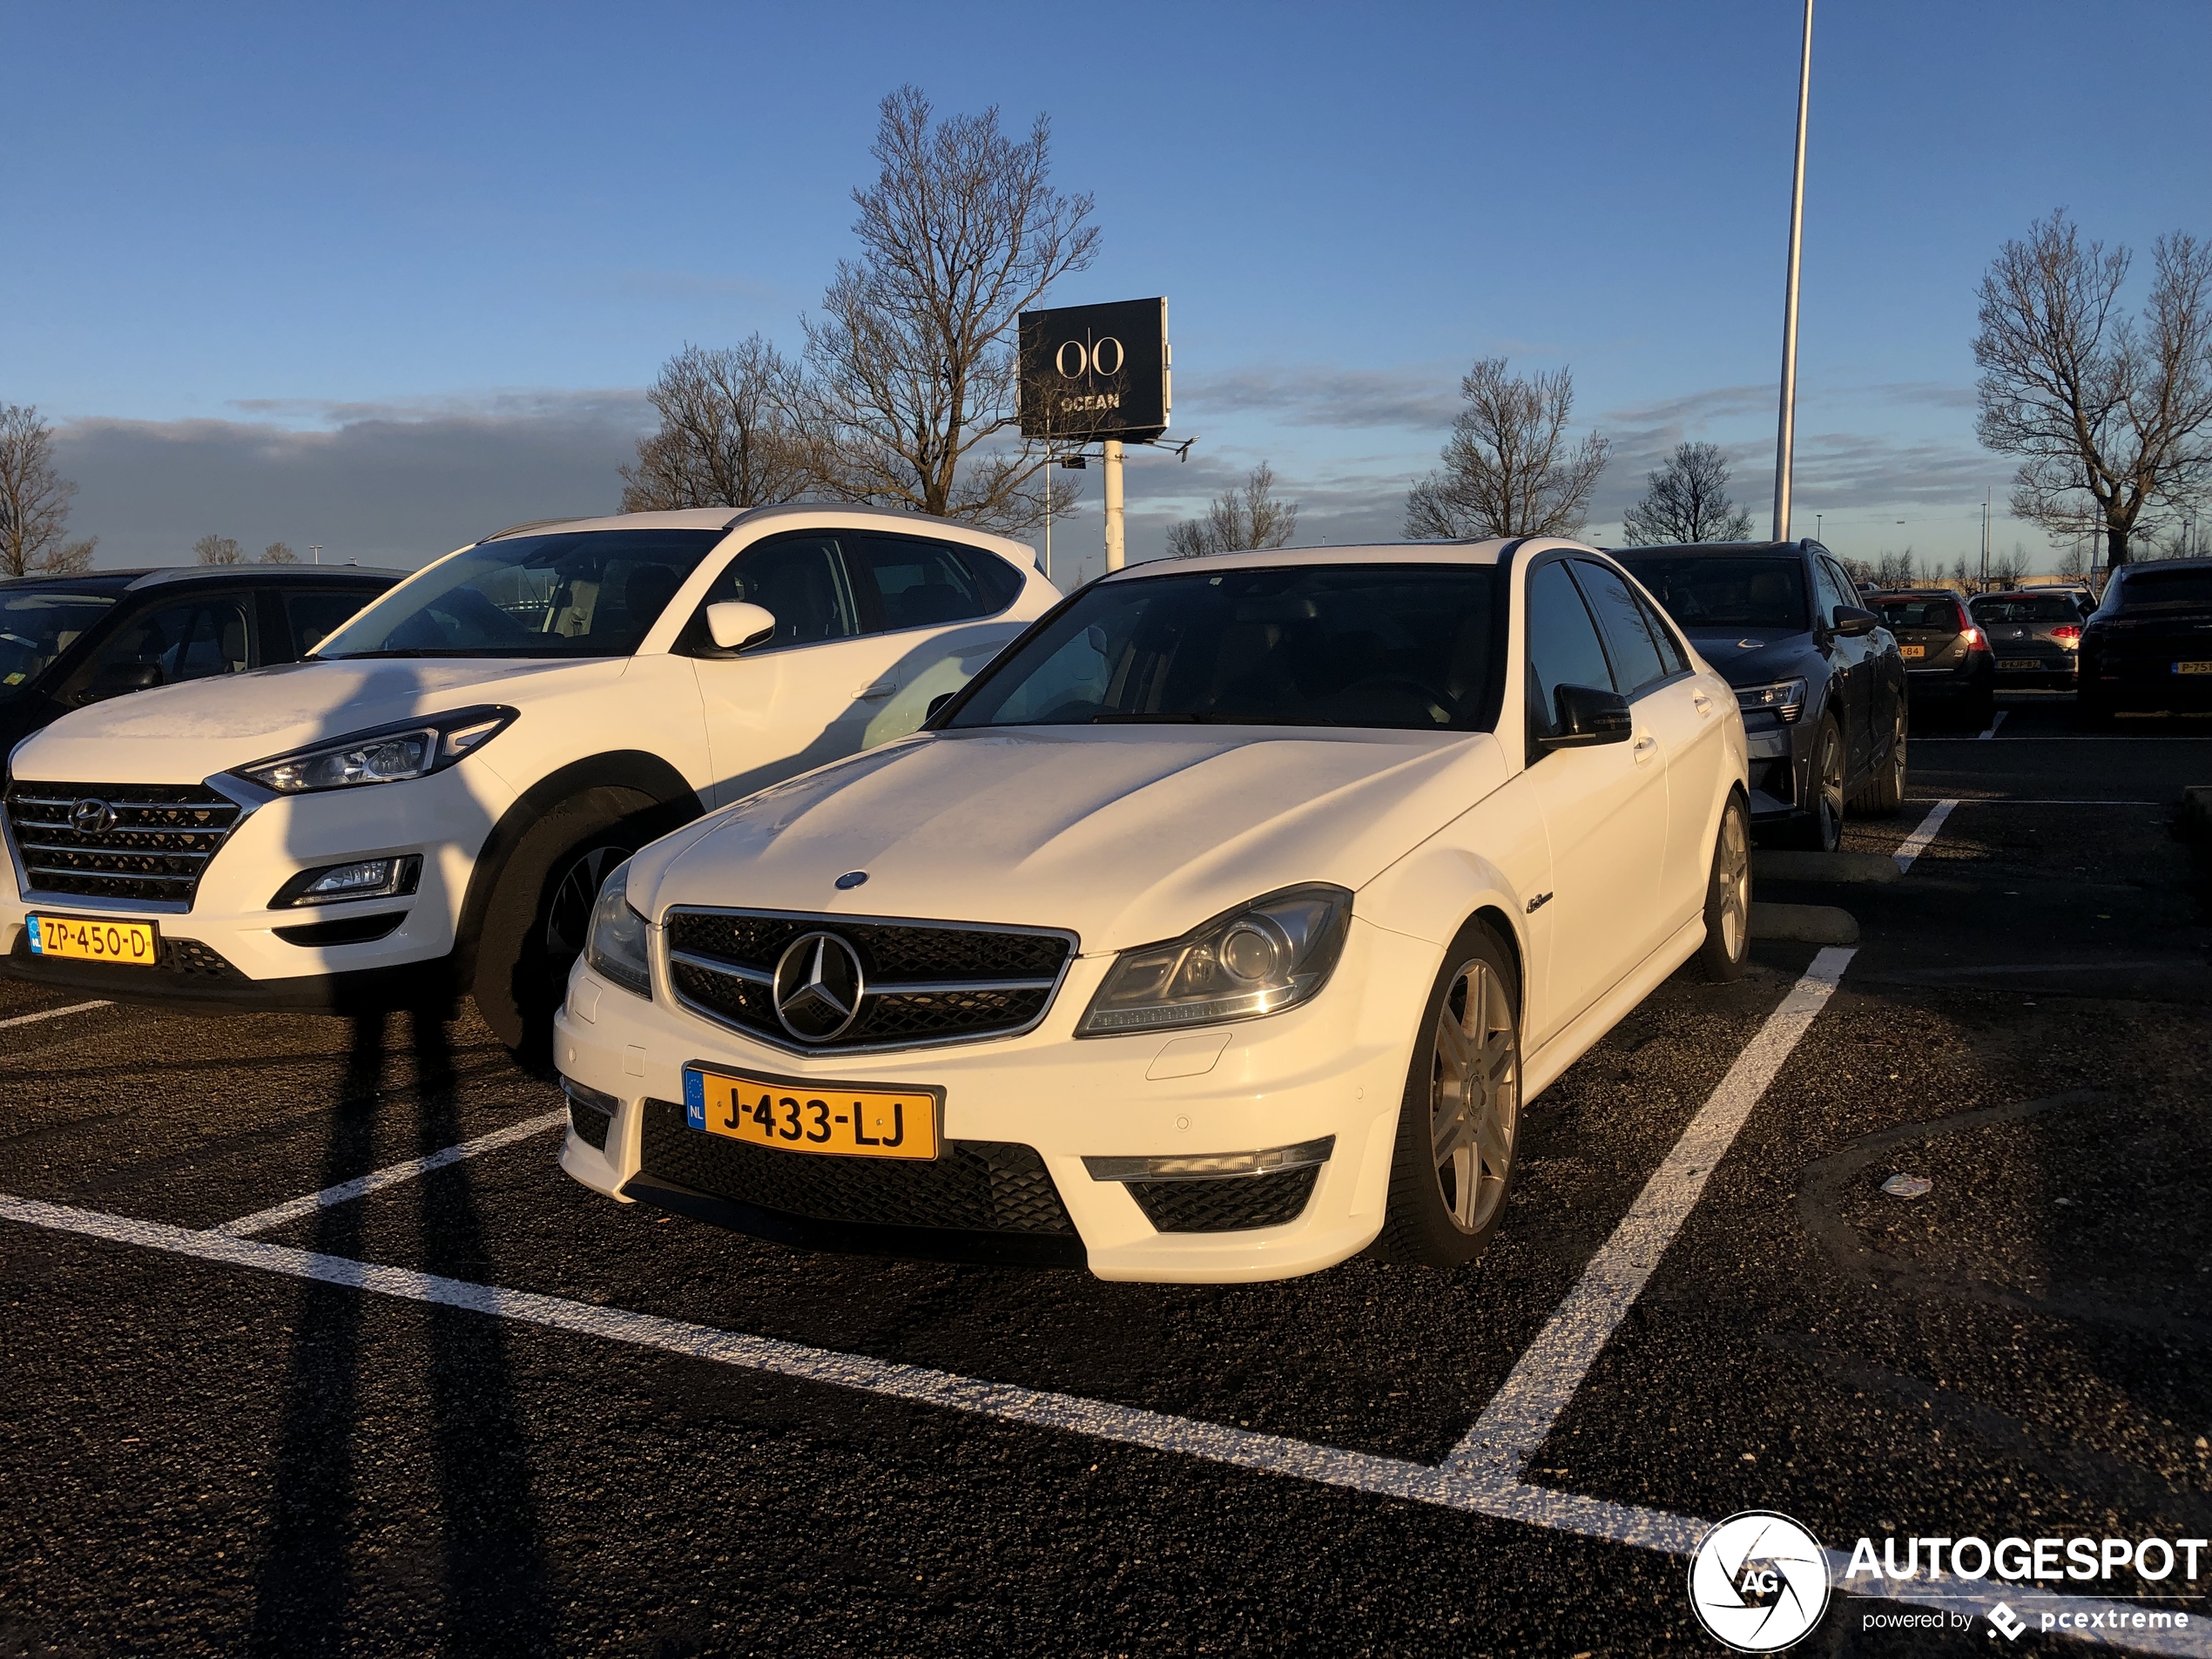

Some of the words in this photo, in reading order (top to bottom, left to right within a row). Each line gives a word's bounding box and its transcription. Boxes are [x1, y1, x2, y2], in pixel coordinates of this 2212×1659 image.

[1061, 393, 1120, 413] OCEAN
[32, 937, 42, 948] NL
[44, 922, 145, 957] ZP-450-D
[690, 1104, 704, 1121] NL
[724, 1088, 904, 1148] J-433-LJ
